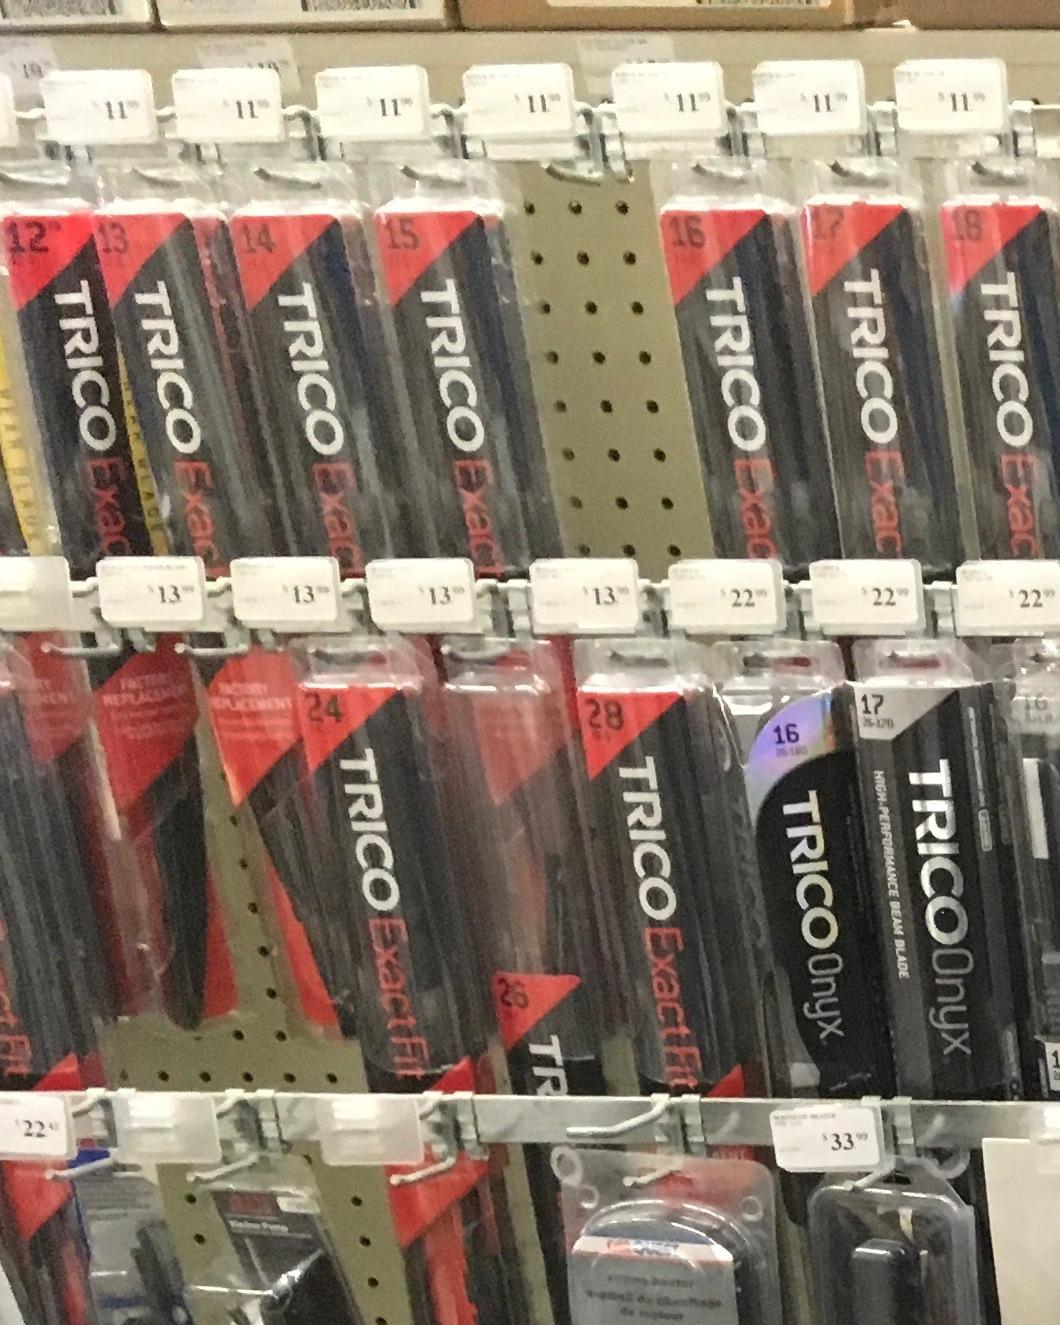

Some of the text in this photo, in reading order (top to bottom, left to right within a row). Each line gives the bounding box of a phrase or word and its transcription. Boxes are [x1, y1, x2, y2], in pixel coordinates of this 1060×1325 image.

[7, 222, 49, 253] 12
[242, 223, 275, 253] 14
[387, 220, 419, 249] 15
[670, 217, 706, 249] 16
[952, 210, 982, 241] 18
[55, 280, 116, 450] TRICO
[134, 280, 201, 453] TRICO
[278, 281, 344, 455] TRICO
[420, 279, 485, 451] TRICO
[706, 276, 767, 451] TRICO
[844, 269, 898, 444] TRICO
[981, 272, 1034, 446] TRICO
[309, 693, 344, 722] 24
[587, 699, 624, 729] 28
[773, 723, 799, 744] 16
[861, 694, 884, 715] 17
[339, 747, 400, 912] TRICO
[618, 755, 677, 921] TRICO
[782, 789, 839, 949] TRICO
[874, 770, 910, 979] HIGH-PERFORMANCE BEAM BLADE
[908, 759, 974, 1056] TRICO Onyx
[803, 952, 845, 1040] Onyx
